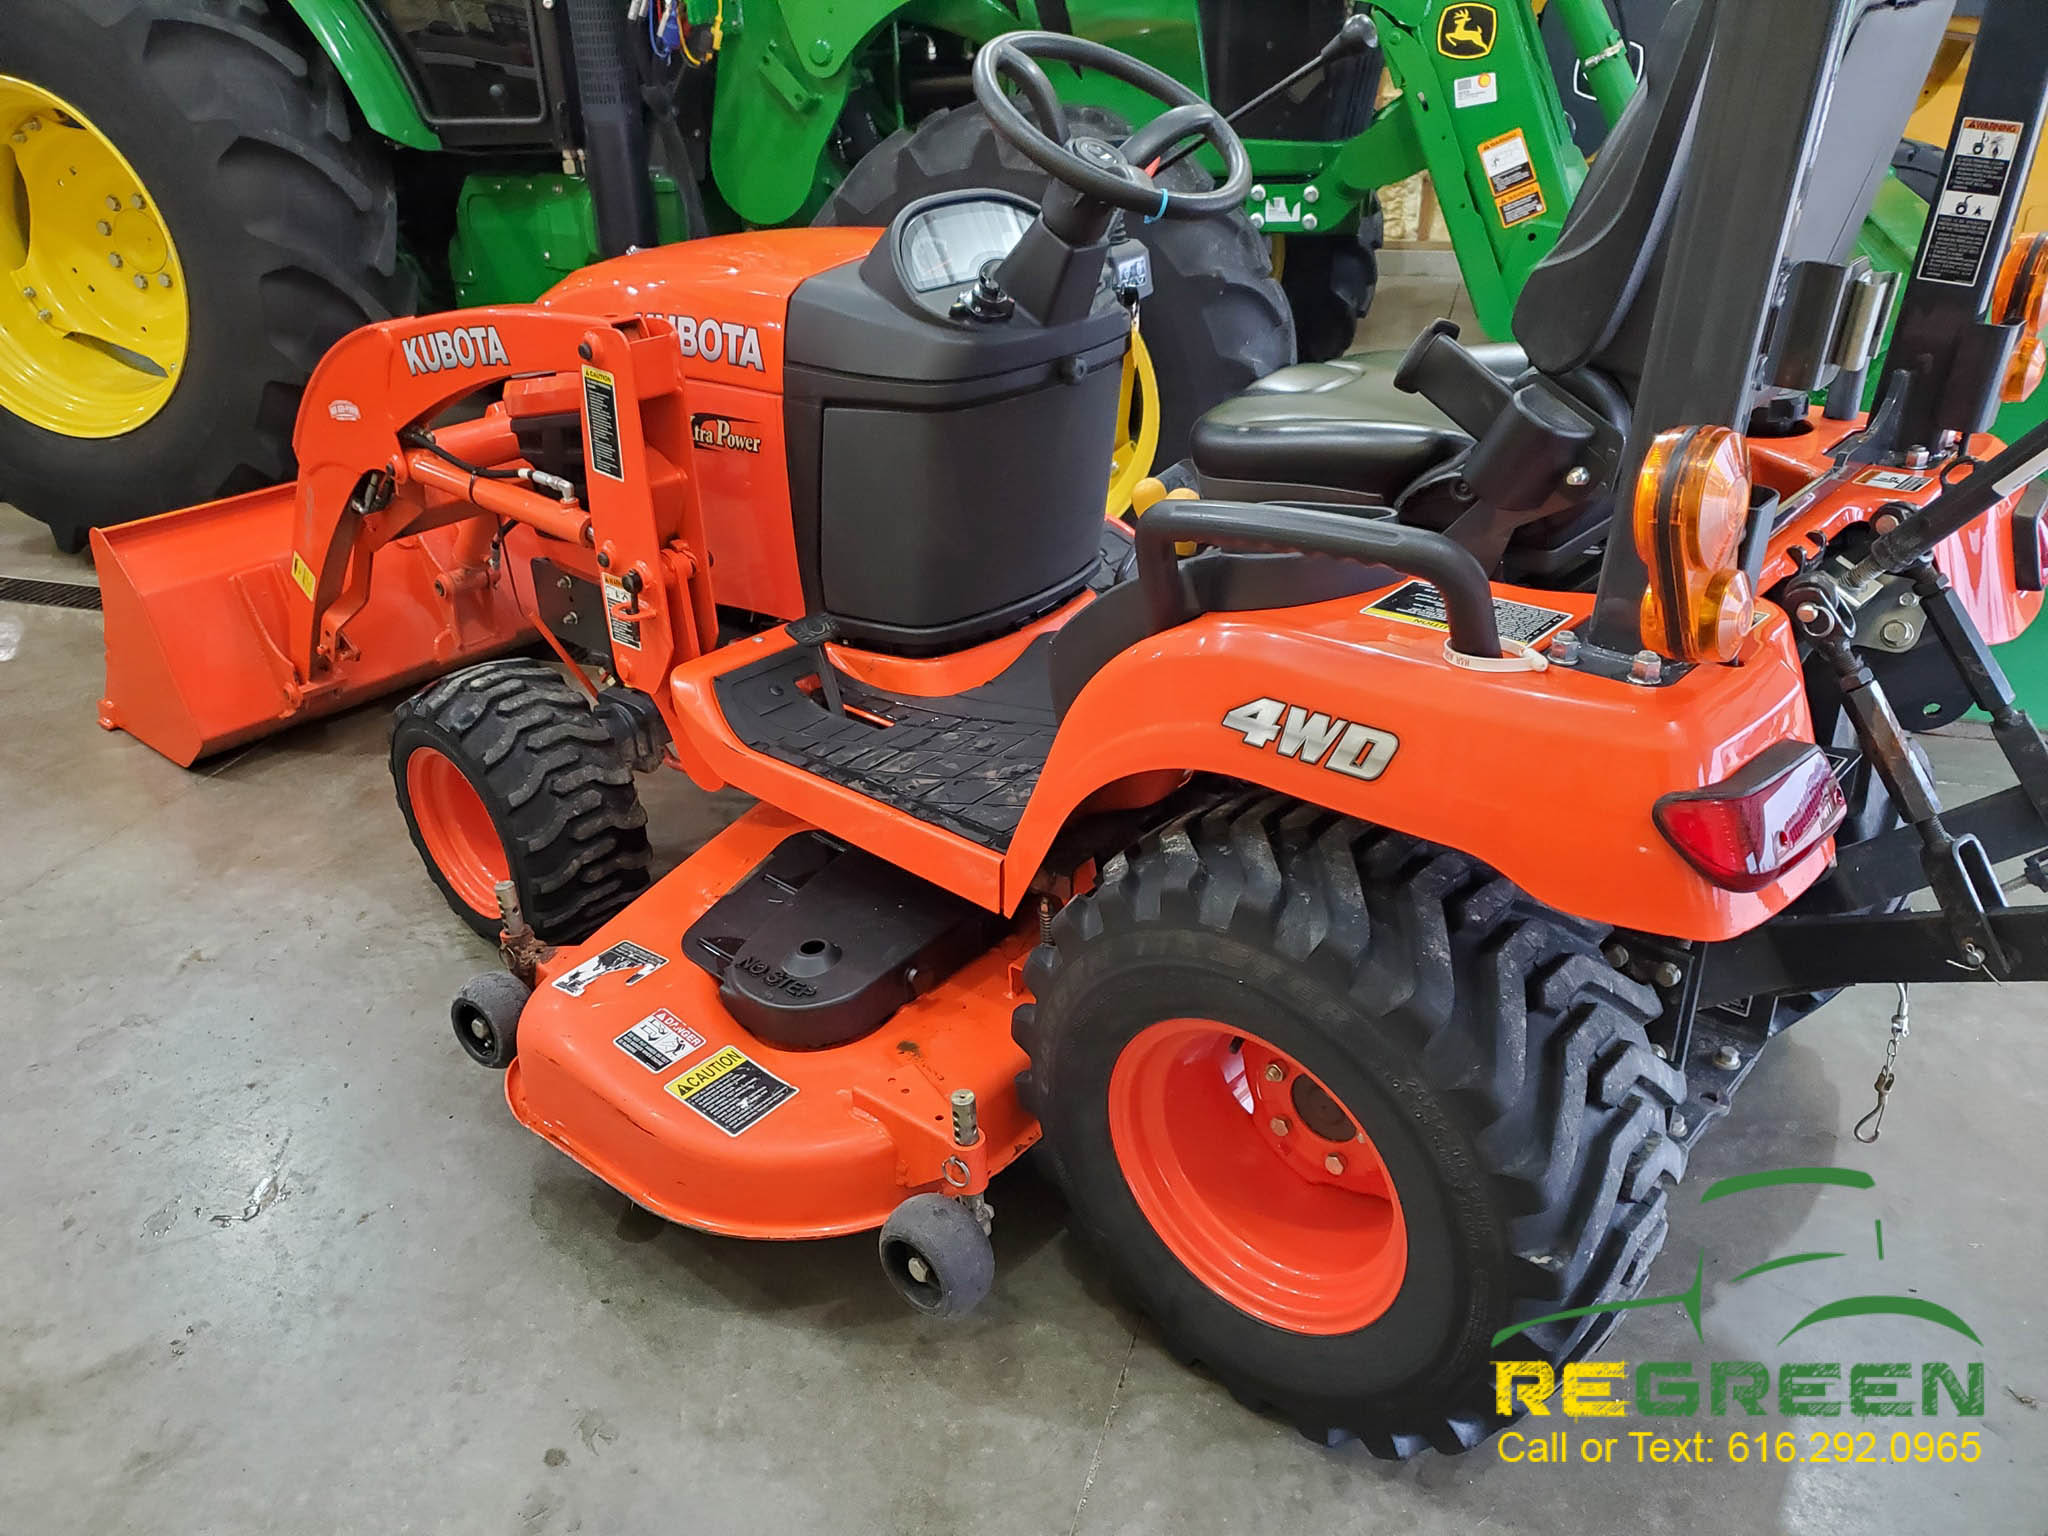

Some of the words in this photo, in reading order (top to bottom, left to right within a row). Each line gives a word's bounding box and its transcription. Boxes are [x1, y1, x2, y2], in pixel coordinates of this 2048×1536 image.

[401, 325, 511, 376] KUBOTA
[690, 416, 714, 445] tra
[716, 418, 761, 453] Power
[1221, 696, 1400, 782] 4WD
[736, 956, 769, 976] NO
[766, 968, 818, 999] STEP
[663, 1016, 701, 1047] DANGER
[686, 1050, 743, 1088] CAUTION
